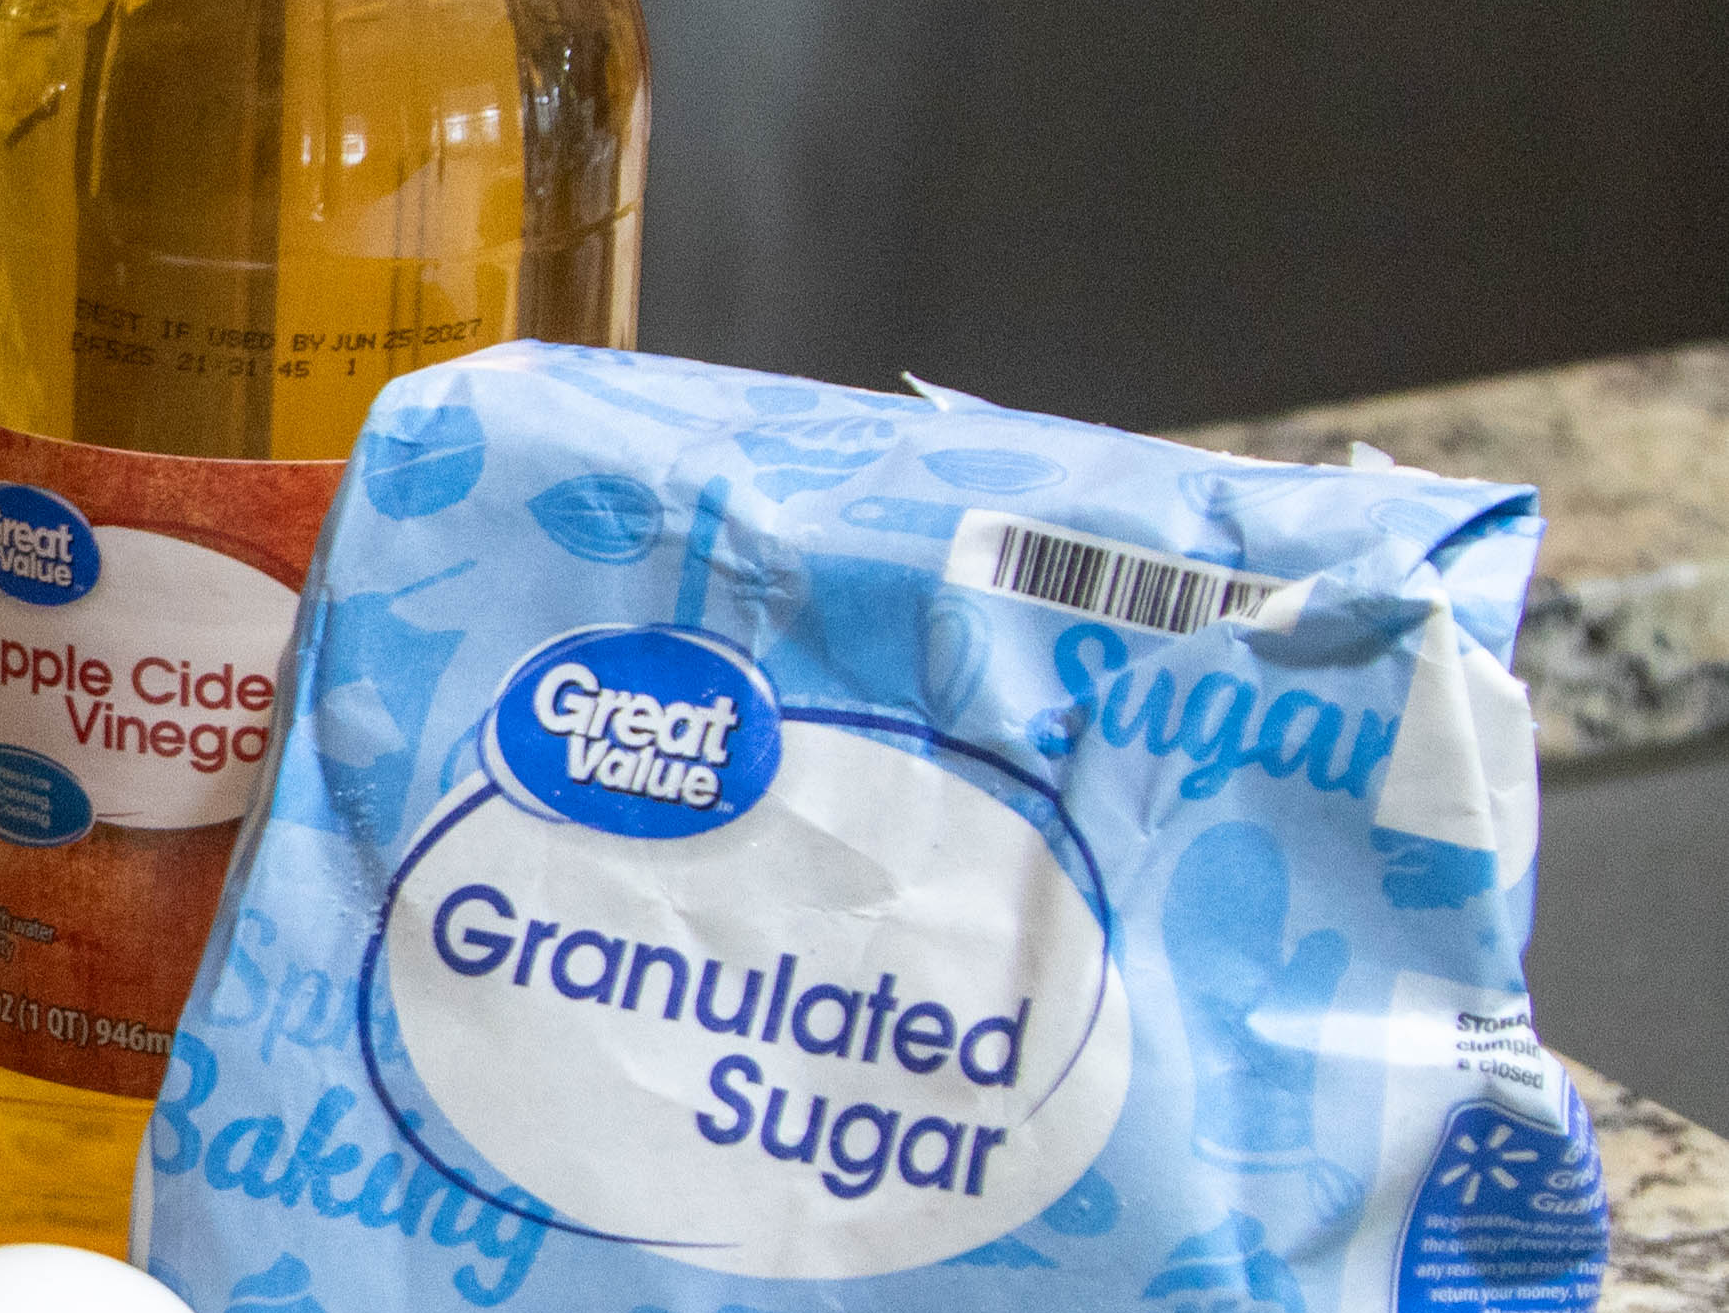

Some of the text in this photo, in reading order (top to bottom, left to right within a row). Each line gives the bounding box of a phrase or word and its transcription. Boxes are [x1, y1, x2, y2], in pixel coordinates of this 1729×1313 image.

[163, 319, 189, 339] IF
[209, 327, 276, 351] USED
[293, 333, 326, 351] BY
[330, 332, 376, 351] JUN
[383, 330, 413, 350] 25
[422, 319, 482, 344] 2027
[130, 657, 276, 713] Cide
[530, 662, 739, 767] Great
[64, 695, 271, 774] Vinega
[565, 733, 721, 808] Value
[18, 996, 40, 1032] (1
[47, 1007, 89, 1047] QT)
[432, 883, 1033, 1087] Granulated
[695, 1052, 1008, 1200] Sugar
[1430, 1286, 1573, 1304] return your money.
